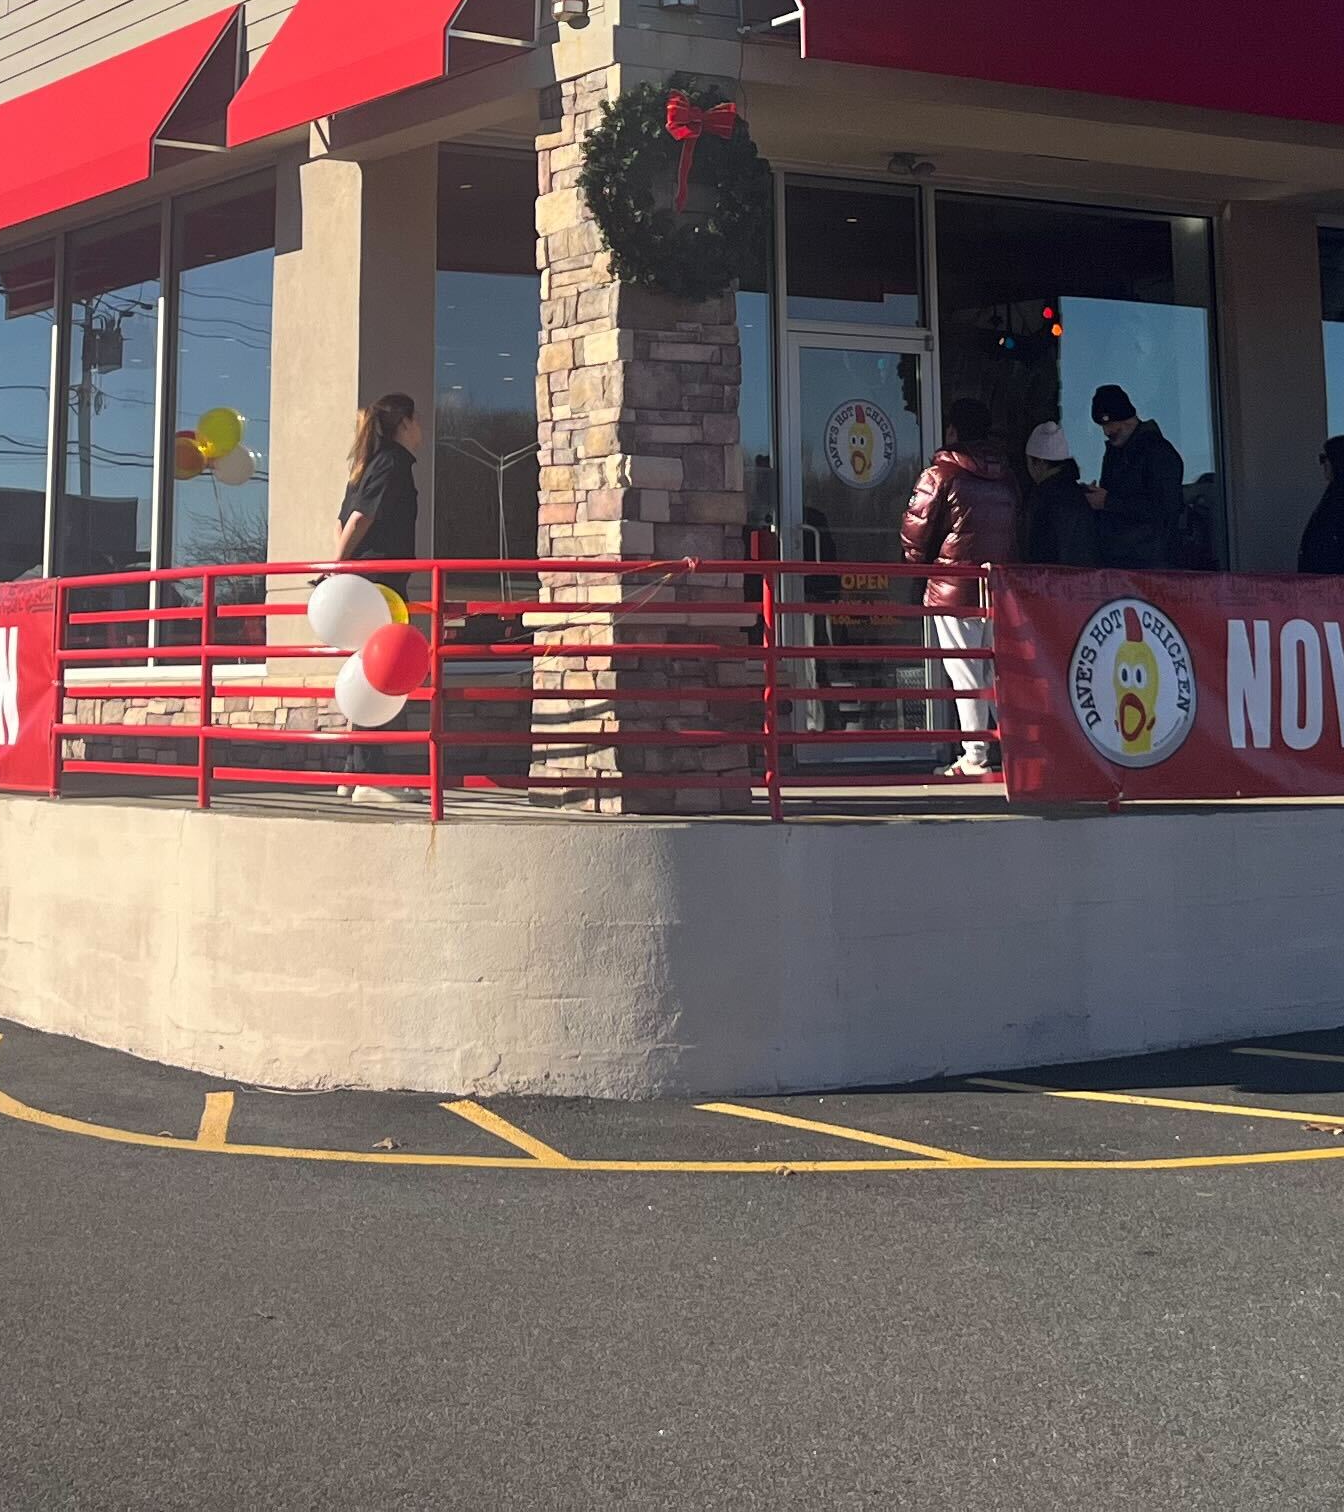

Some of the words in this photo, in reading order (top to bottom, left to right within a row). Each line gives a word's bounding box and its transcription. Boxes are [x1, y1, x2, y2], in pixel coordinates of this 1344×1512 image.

[835, 406, 854, 426] HOT
[865, 407, 893, 460] CHICKEN
[841, 573, 889, 590] OPEN
[1076, 646, 1102, 731] DAVE'S
[1090, 609, 1123, 647] HOT
[1142, 611, 1192, 713] CHICKEN
